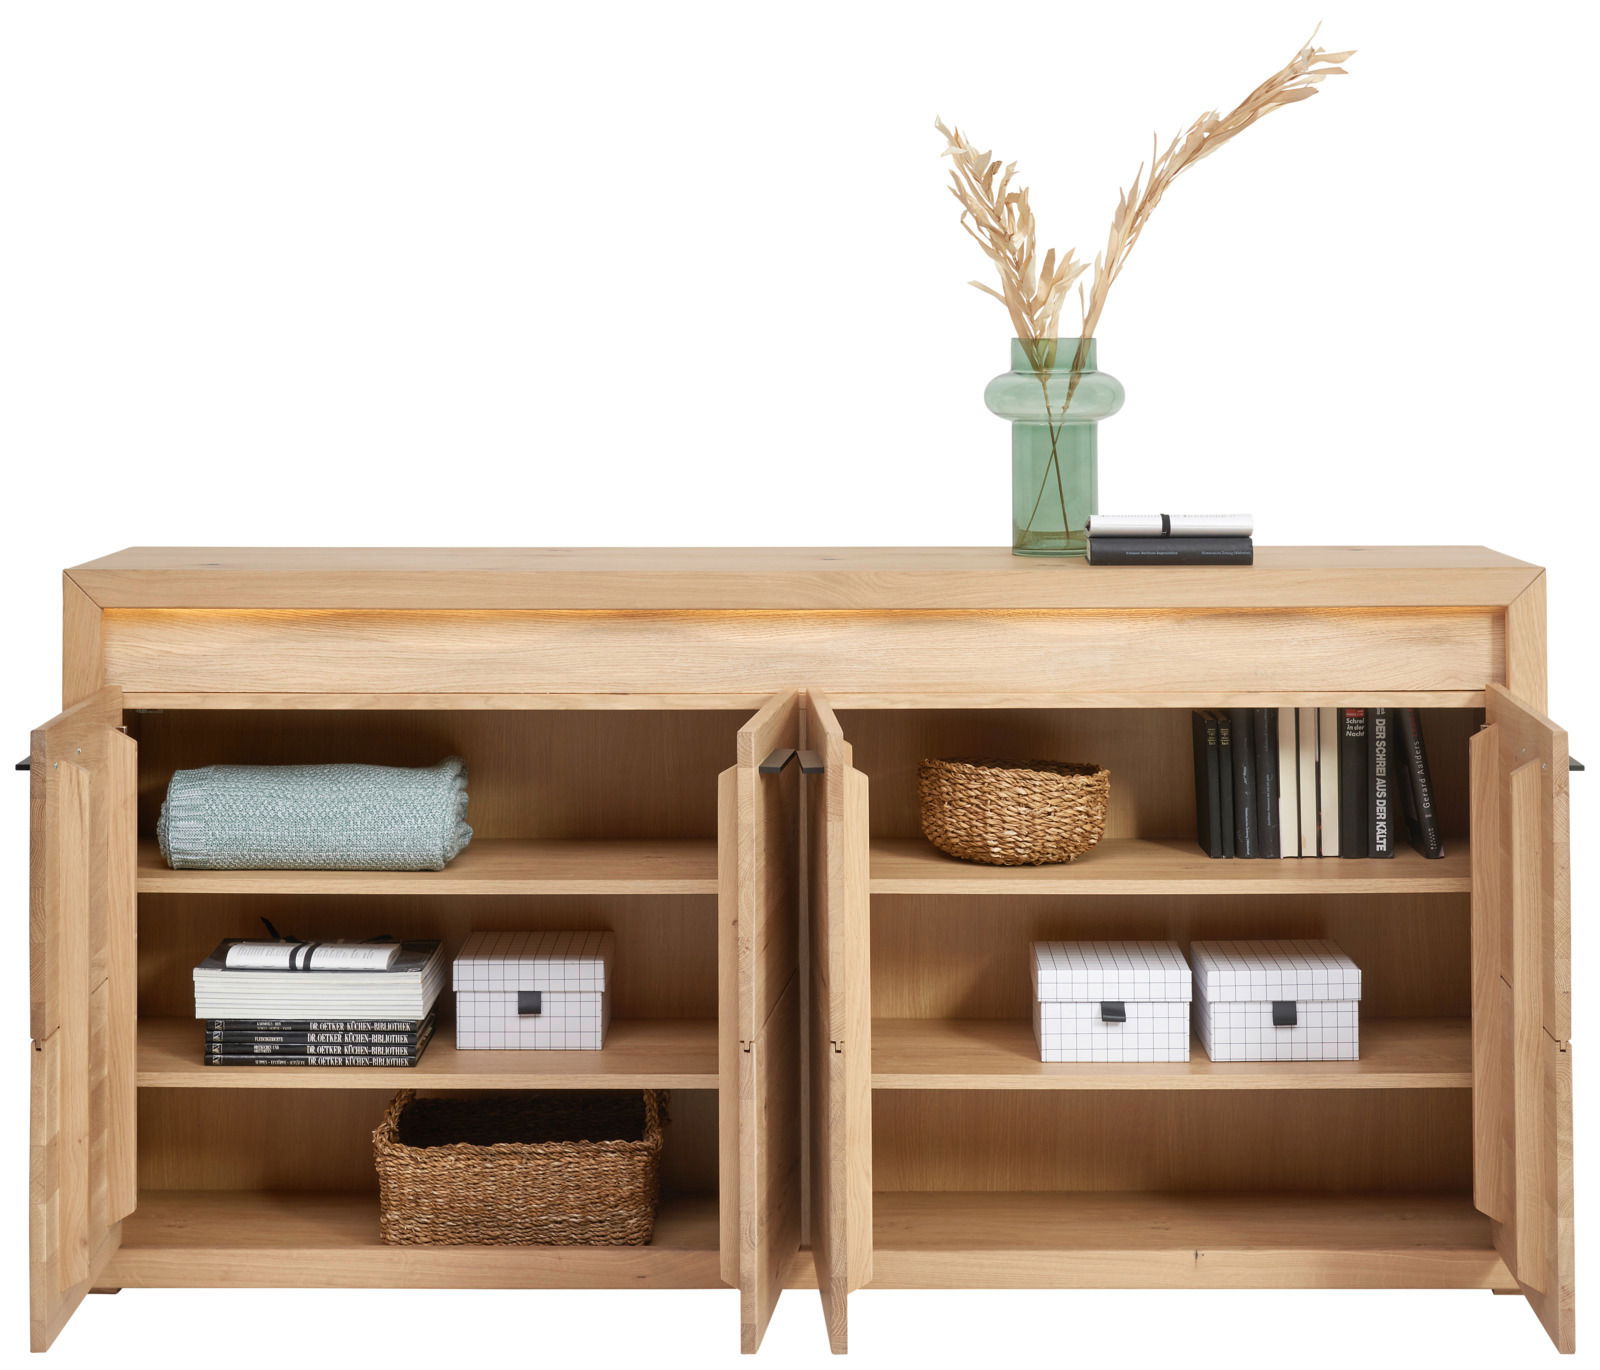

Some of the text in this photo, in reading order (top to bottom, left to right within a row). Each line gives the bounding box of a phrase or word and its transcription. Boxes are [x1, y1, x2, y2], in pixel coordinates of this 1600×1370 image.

[1375, 718, 1387, 739] DER
[1375, 740, 1387, 776] SCHREI
[1413, 740, 1431, 809] Gerard Aalders
[1375, 777, 1387, 799] AUS
[1375, 799, 1387, 820] DER
[1375, 821, 1387, 852] KÄLTE
[346, 1021, 411, 1031] KÜCHEN-BIBLIOTHEK
[344, 1032, 409, 1044] KÜCHEN-BIBLIOTHEK
[344, 1044, 409, 1056] KÜCHEN-BIBLIOTHEK
[345, 1055, 409, 1067] KÜCHEN-BIBLIOTHEK
